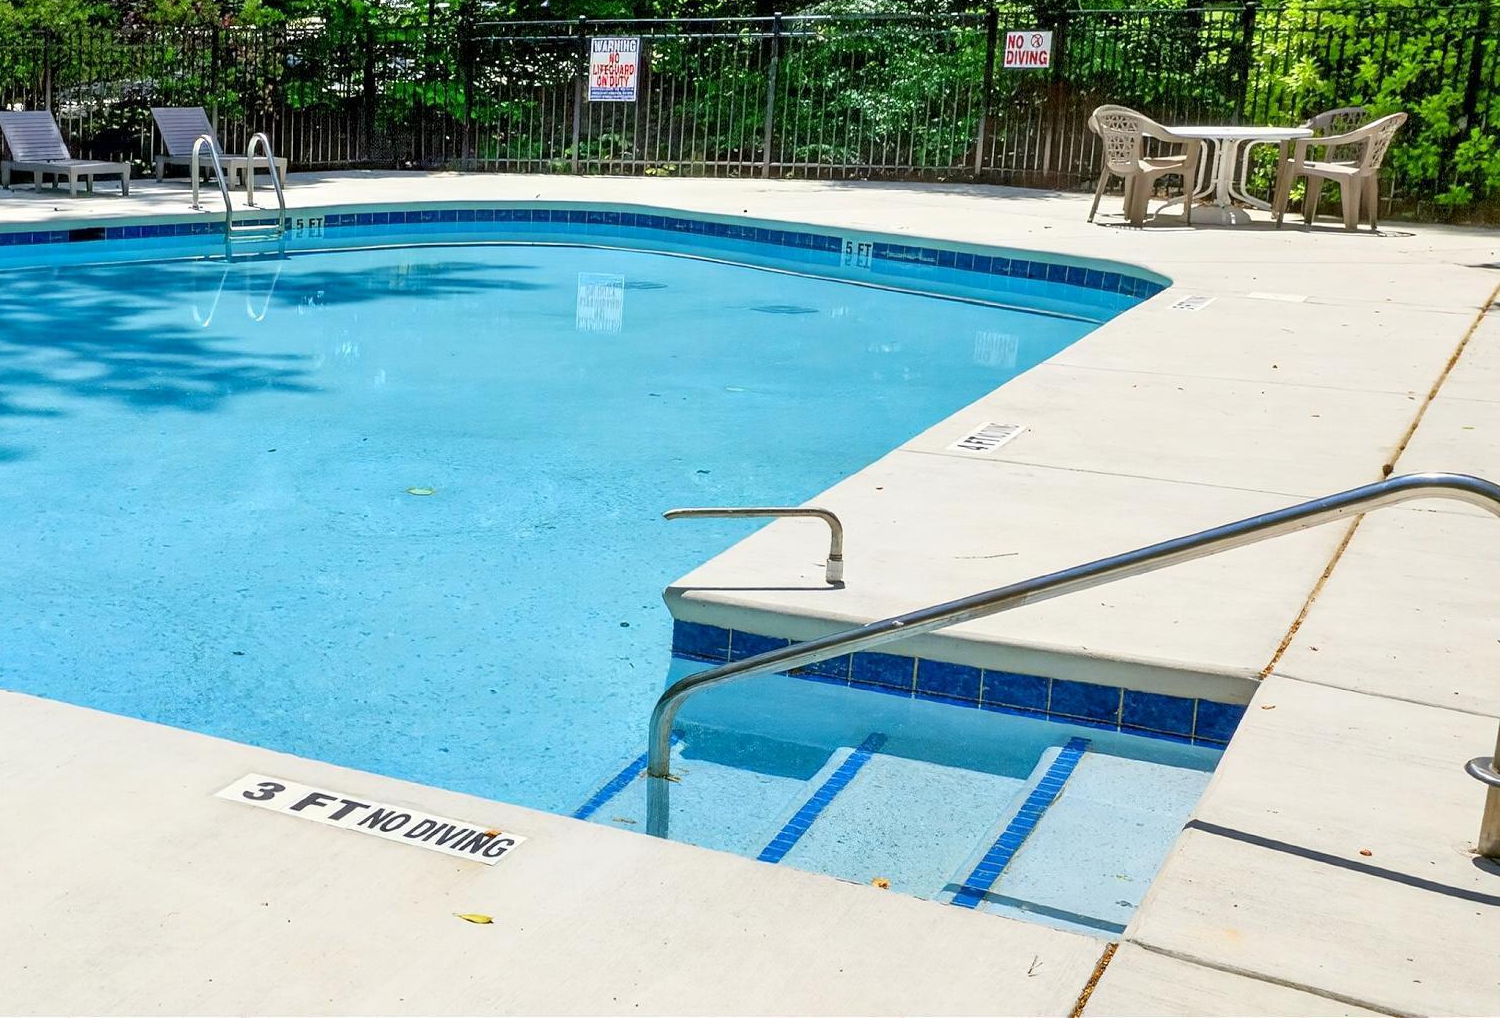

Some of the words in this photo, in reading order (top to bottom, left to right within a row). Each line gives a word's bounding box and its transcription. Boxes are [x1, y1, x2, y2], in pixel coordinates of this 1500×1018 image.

[594, 40, 637, 52] WARNING
[1008, 35, 1024, 49] NO
[609, 53, 620, 64] NO
[1006, 50, 1048, 65] DIVING
[593, 64, 635, 75] LIFEGUARD
[597, 76, 607, 87] ON
[610, 76, 629, 87] DUTY
[296, 218, 304, 230] 5
[308, 217, 323, 229] FT
[845, 241, 853, 255] 5
[857, 242, 872, 257] FT
[242, 782, 286, 801] 3
[289, 792, 371, 822] FT
[357, 808, 412, 833] NO
[403, 818, 515, 859] DIVING
